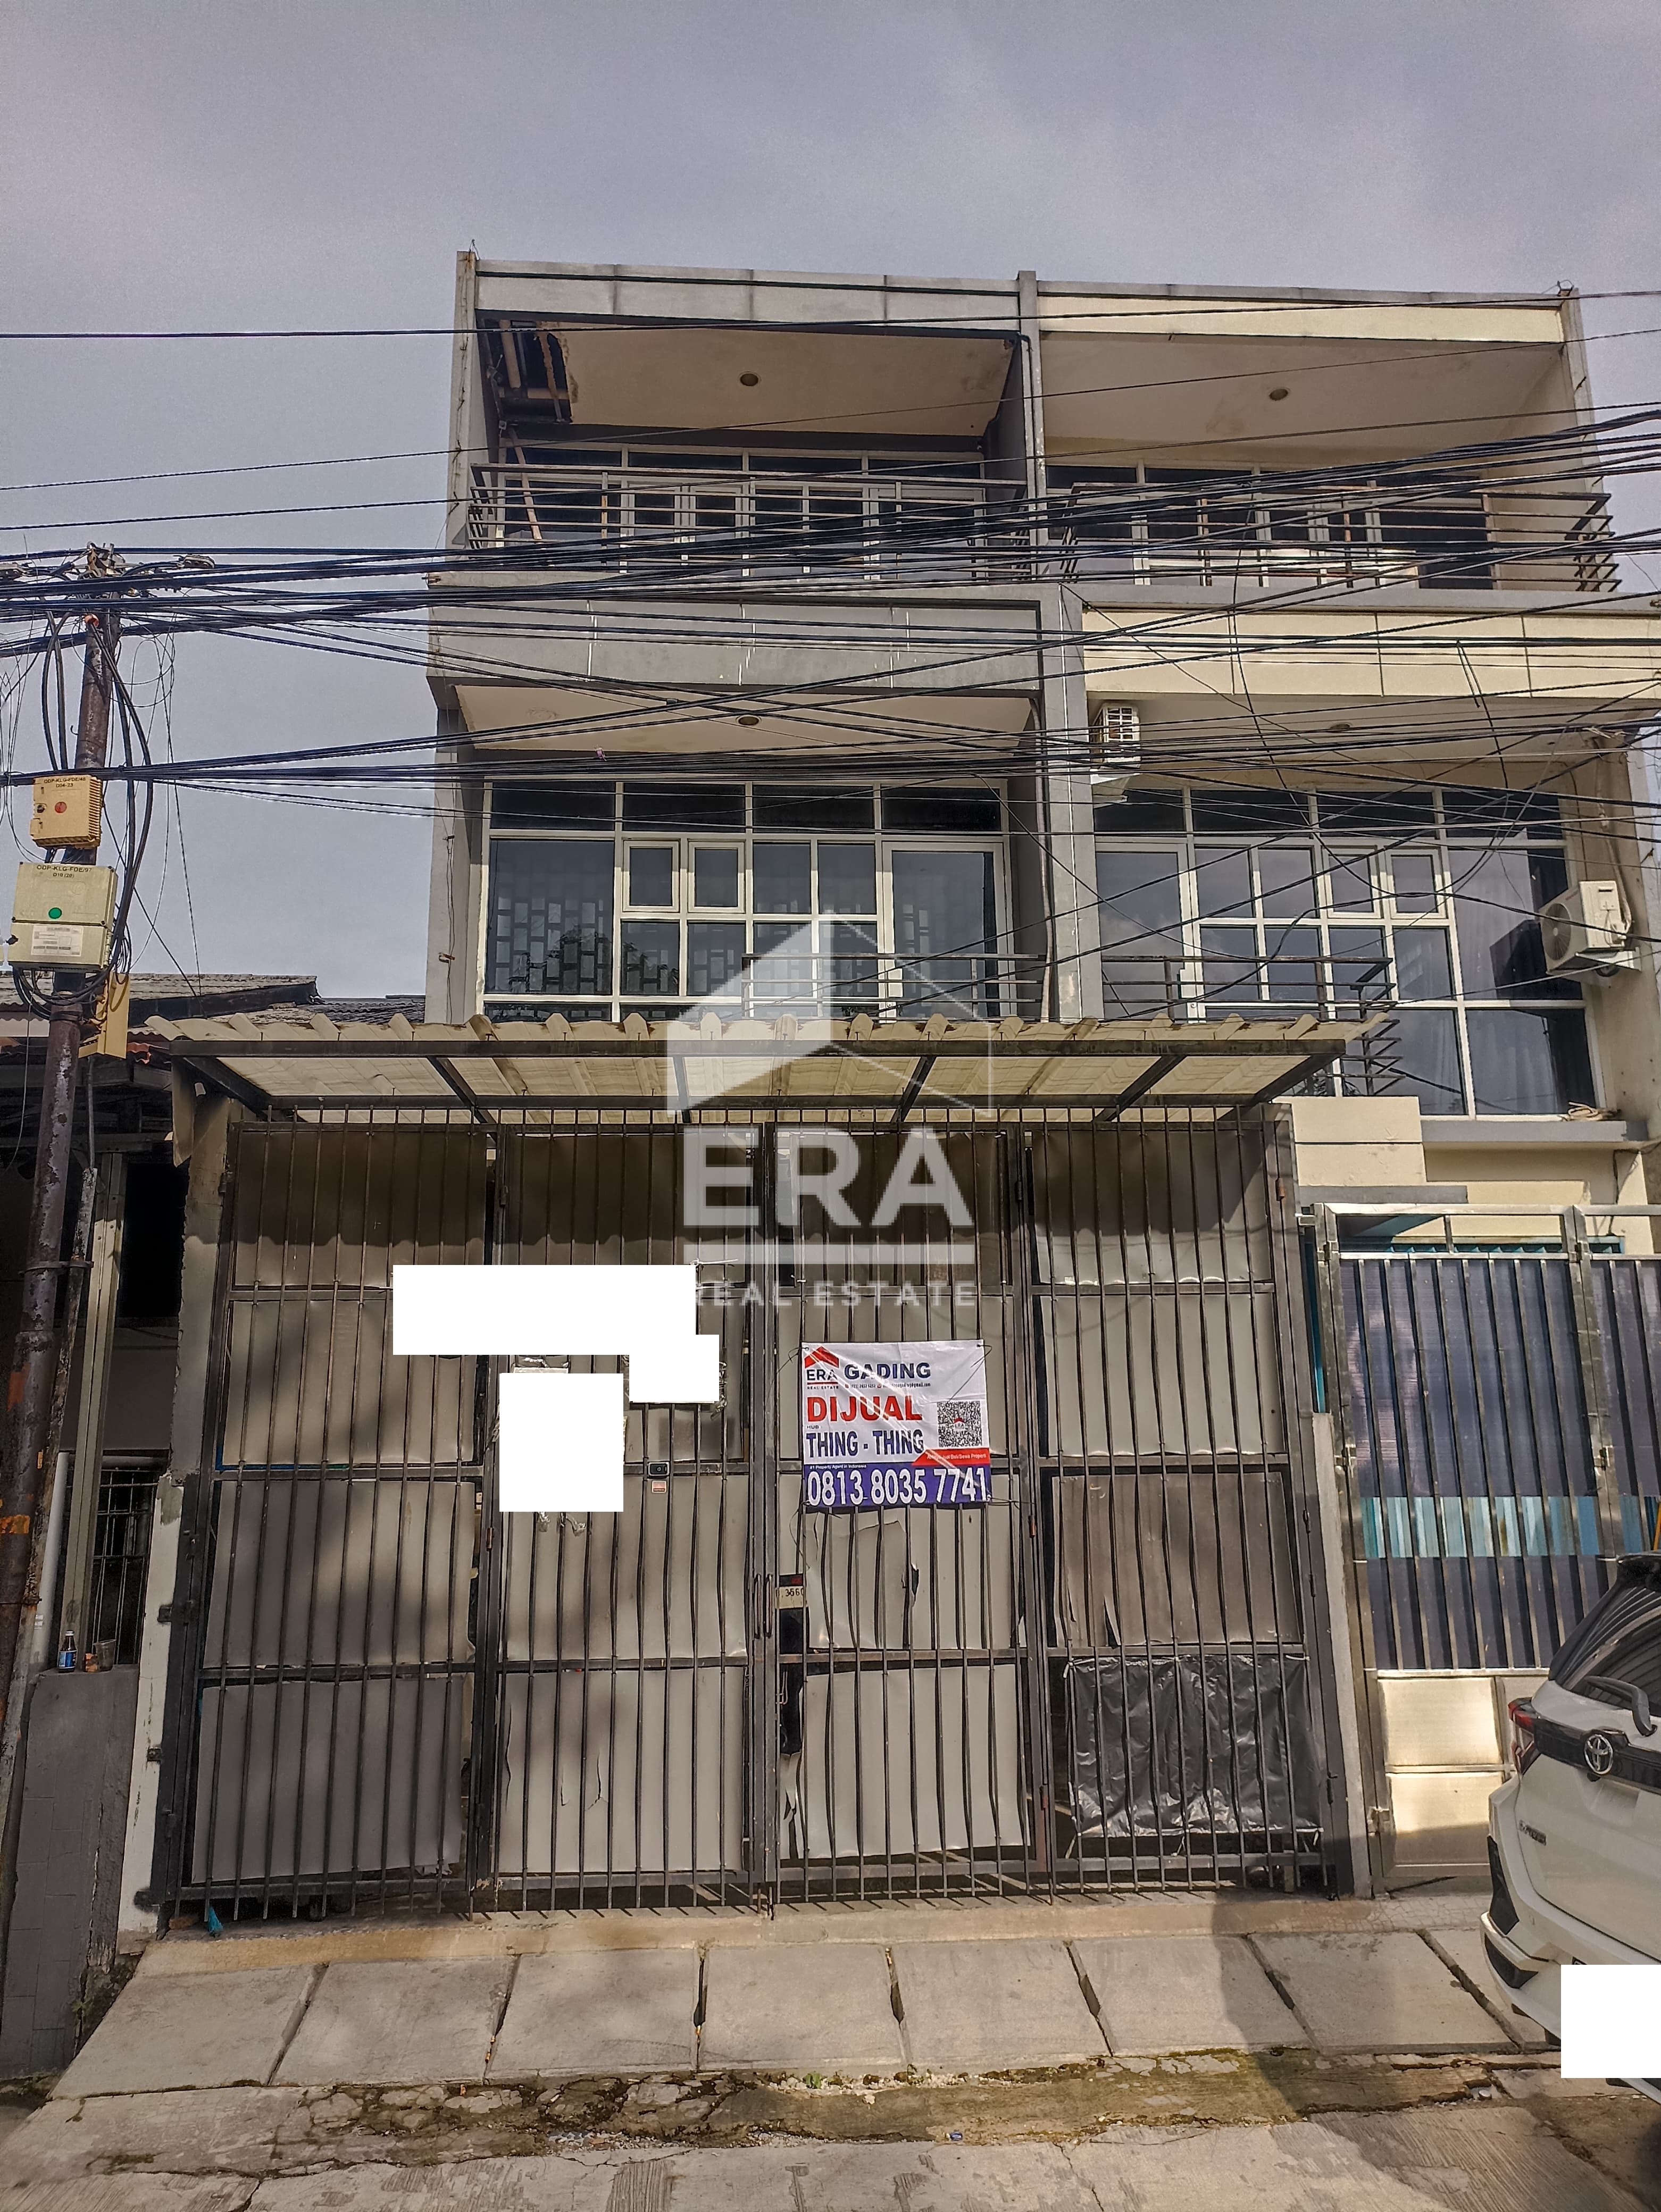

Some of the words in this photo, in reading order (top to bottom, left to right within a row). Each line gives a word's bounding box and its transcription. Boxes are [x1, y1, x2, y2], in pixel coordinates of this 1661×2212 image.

[806, 1369, 838, 1381] ERA
[844, 1362, 931, 1380] GADING
[807, 1395, 923, 1422] DIJUAL
[806, 1430, 858, 1457] THING
[872, 1429, 924, 1455] THING
[807, 1470, 863, 1506] 0813
[871, 1468, 928, 1504] 8035
[933, 1467, 988, 1503] 7741
